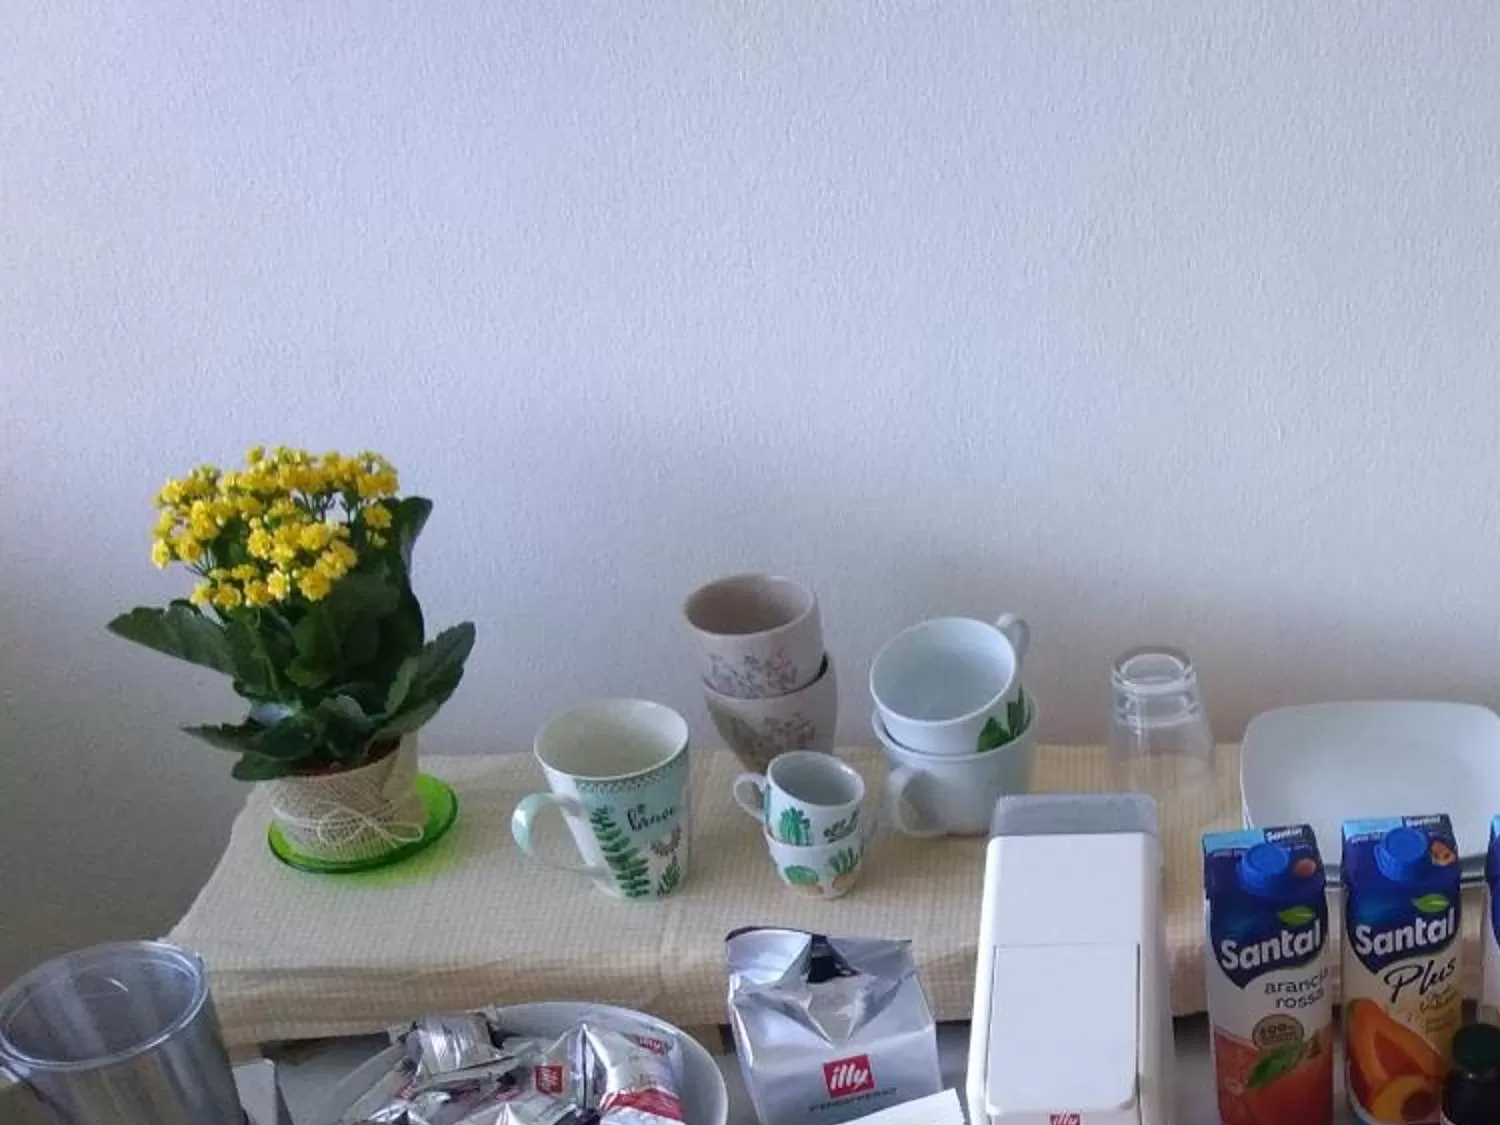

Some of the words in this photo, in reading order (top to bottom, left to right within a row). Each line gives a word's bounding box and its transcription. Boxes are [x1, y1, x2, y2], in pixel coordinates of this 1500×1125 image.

[1220, 918, 1322, 970] Santal
[1354, 906, 1455, 957] Santal
[1384, 957, 1457, 1004] Plus
[829, 1061, 869, 1091] illy
